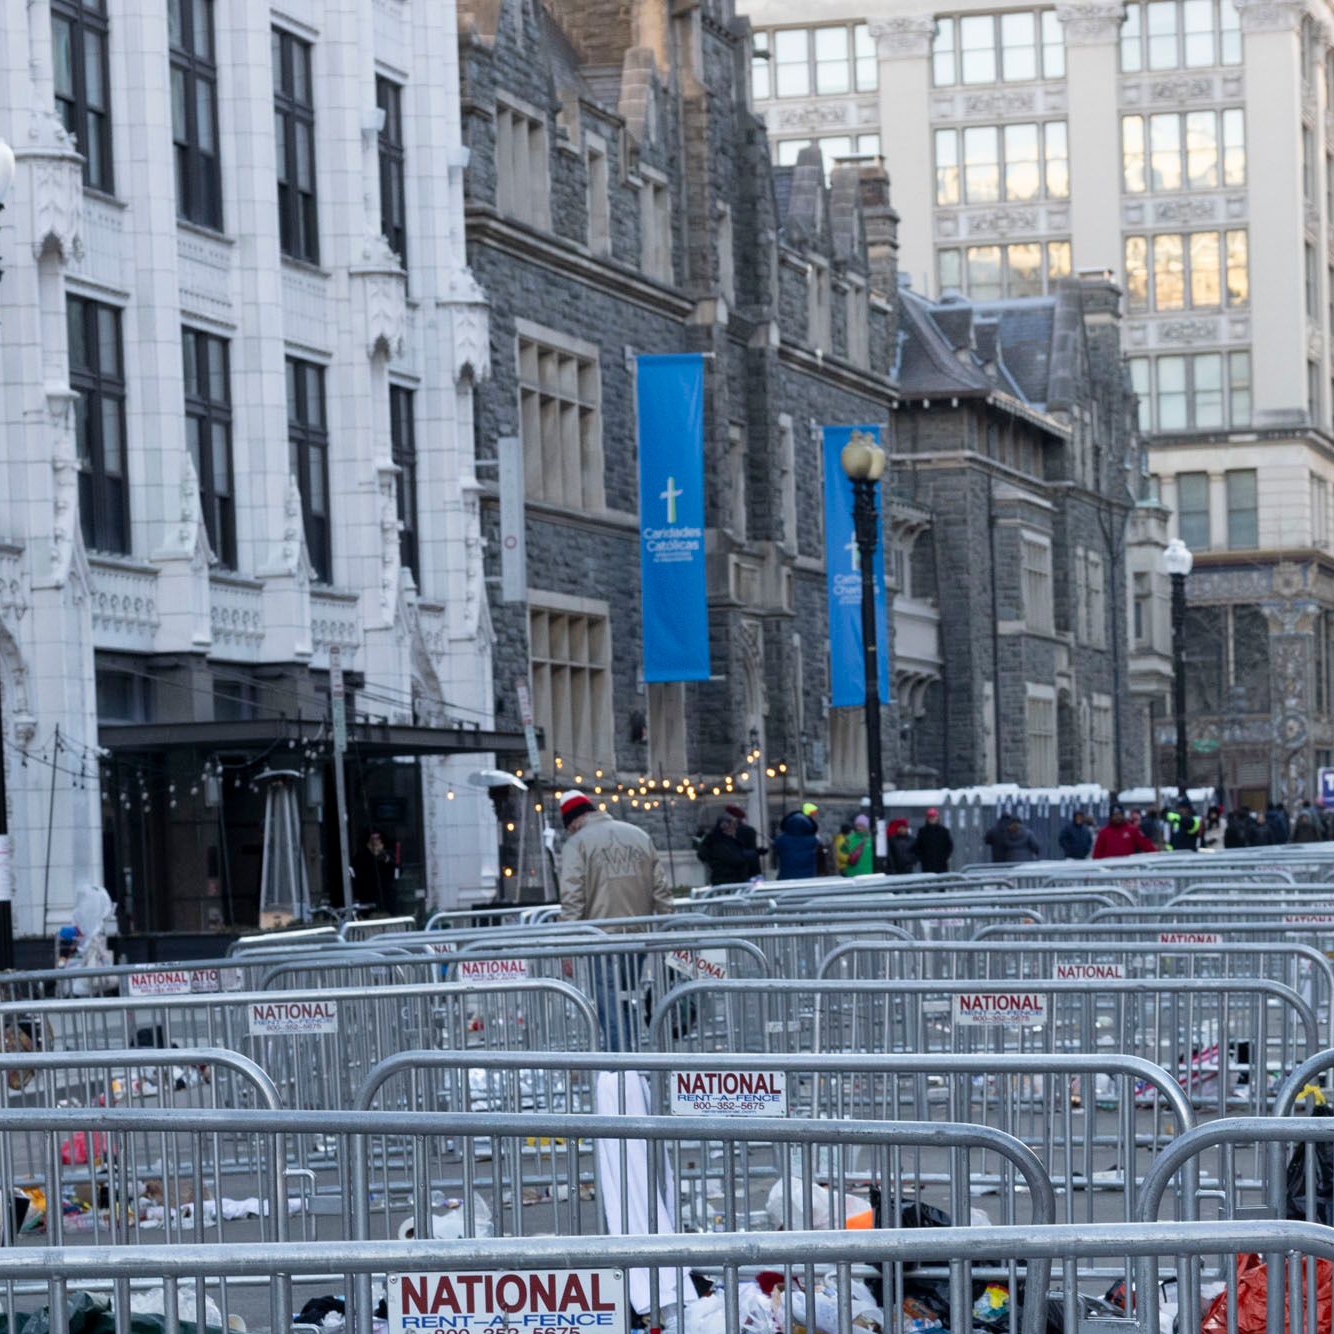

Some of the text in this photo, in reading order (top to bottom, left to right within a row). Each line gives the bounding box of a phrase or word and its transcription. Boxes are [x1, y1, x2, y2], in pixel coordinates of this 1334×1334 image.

[642, 527, 702, 541] Caridades
[462, 959, 527, 975] NATIONAL
[1058, 966, 1123, 979] NATIONAL
[130, 971, 188, 986] NATIONAL
[959, 995, 1043, 1011] NATIONAL
[253, 1003, 336, 1020] NATIONAL
[677, 1072, 782, 1095] NATIONAL
[677, 1094, 781, 1102] RENT-A-FENCE
[692, 1101, 766, 1111] 800-352-5675
[400, 1273, 616, 1315] NATIONAL
[401, 1312, 614, 1329] RENT-A-FENCE
